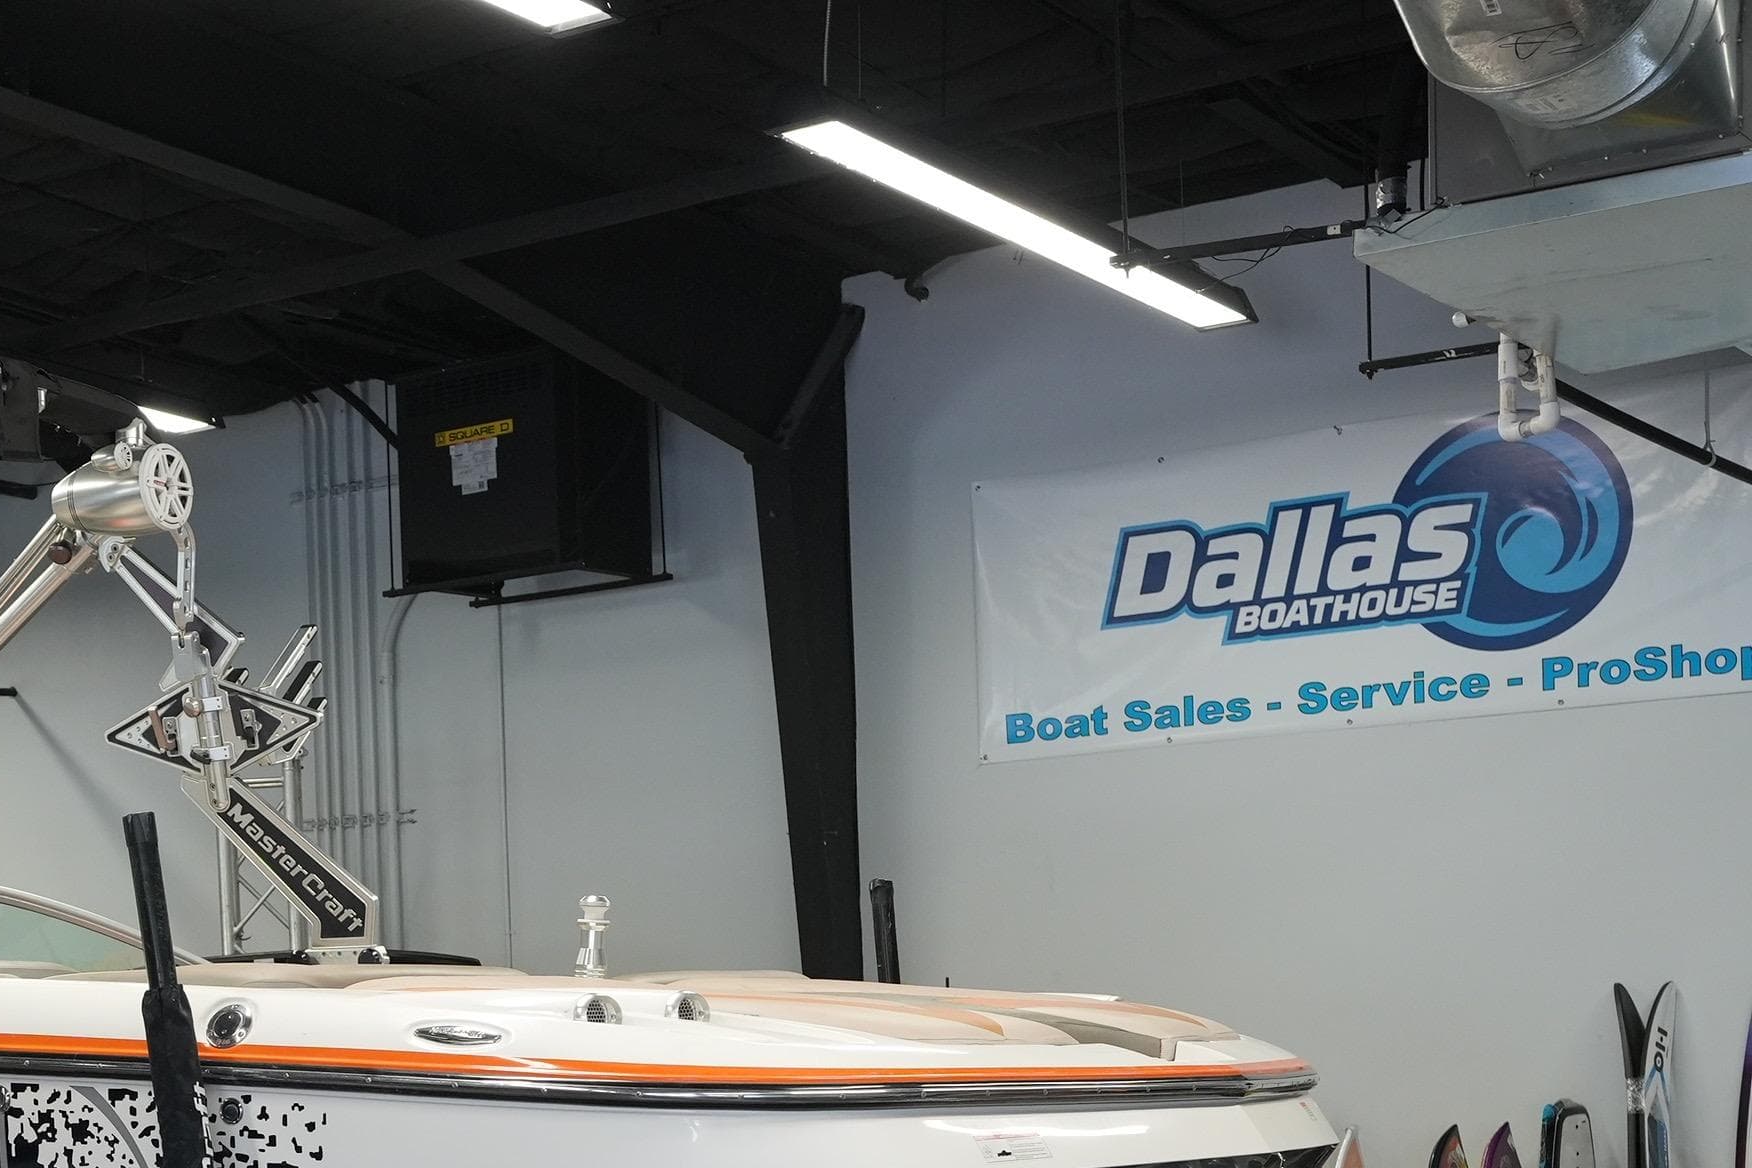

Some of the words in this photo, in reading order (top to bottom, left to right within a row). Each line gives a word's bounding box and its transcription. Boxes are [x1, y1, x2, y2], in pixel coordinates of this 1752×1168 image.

[448, 425, 495, 441] SQUARE
[500, 422, 510, 432] D
[1110, 495, 1478, 618] Dallas
[1234, 579, 1463, 635] BOATHOUSE
[1005, 705, 1109, 745] Boat
[1123, 694, 1251, 732] Sales
[1296, 671, 1490, 715] Service
[226, 802, 363, 933] MasterCraft
